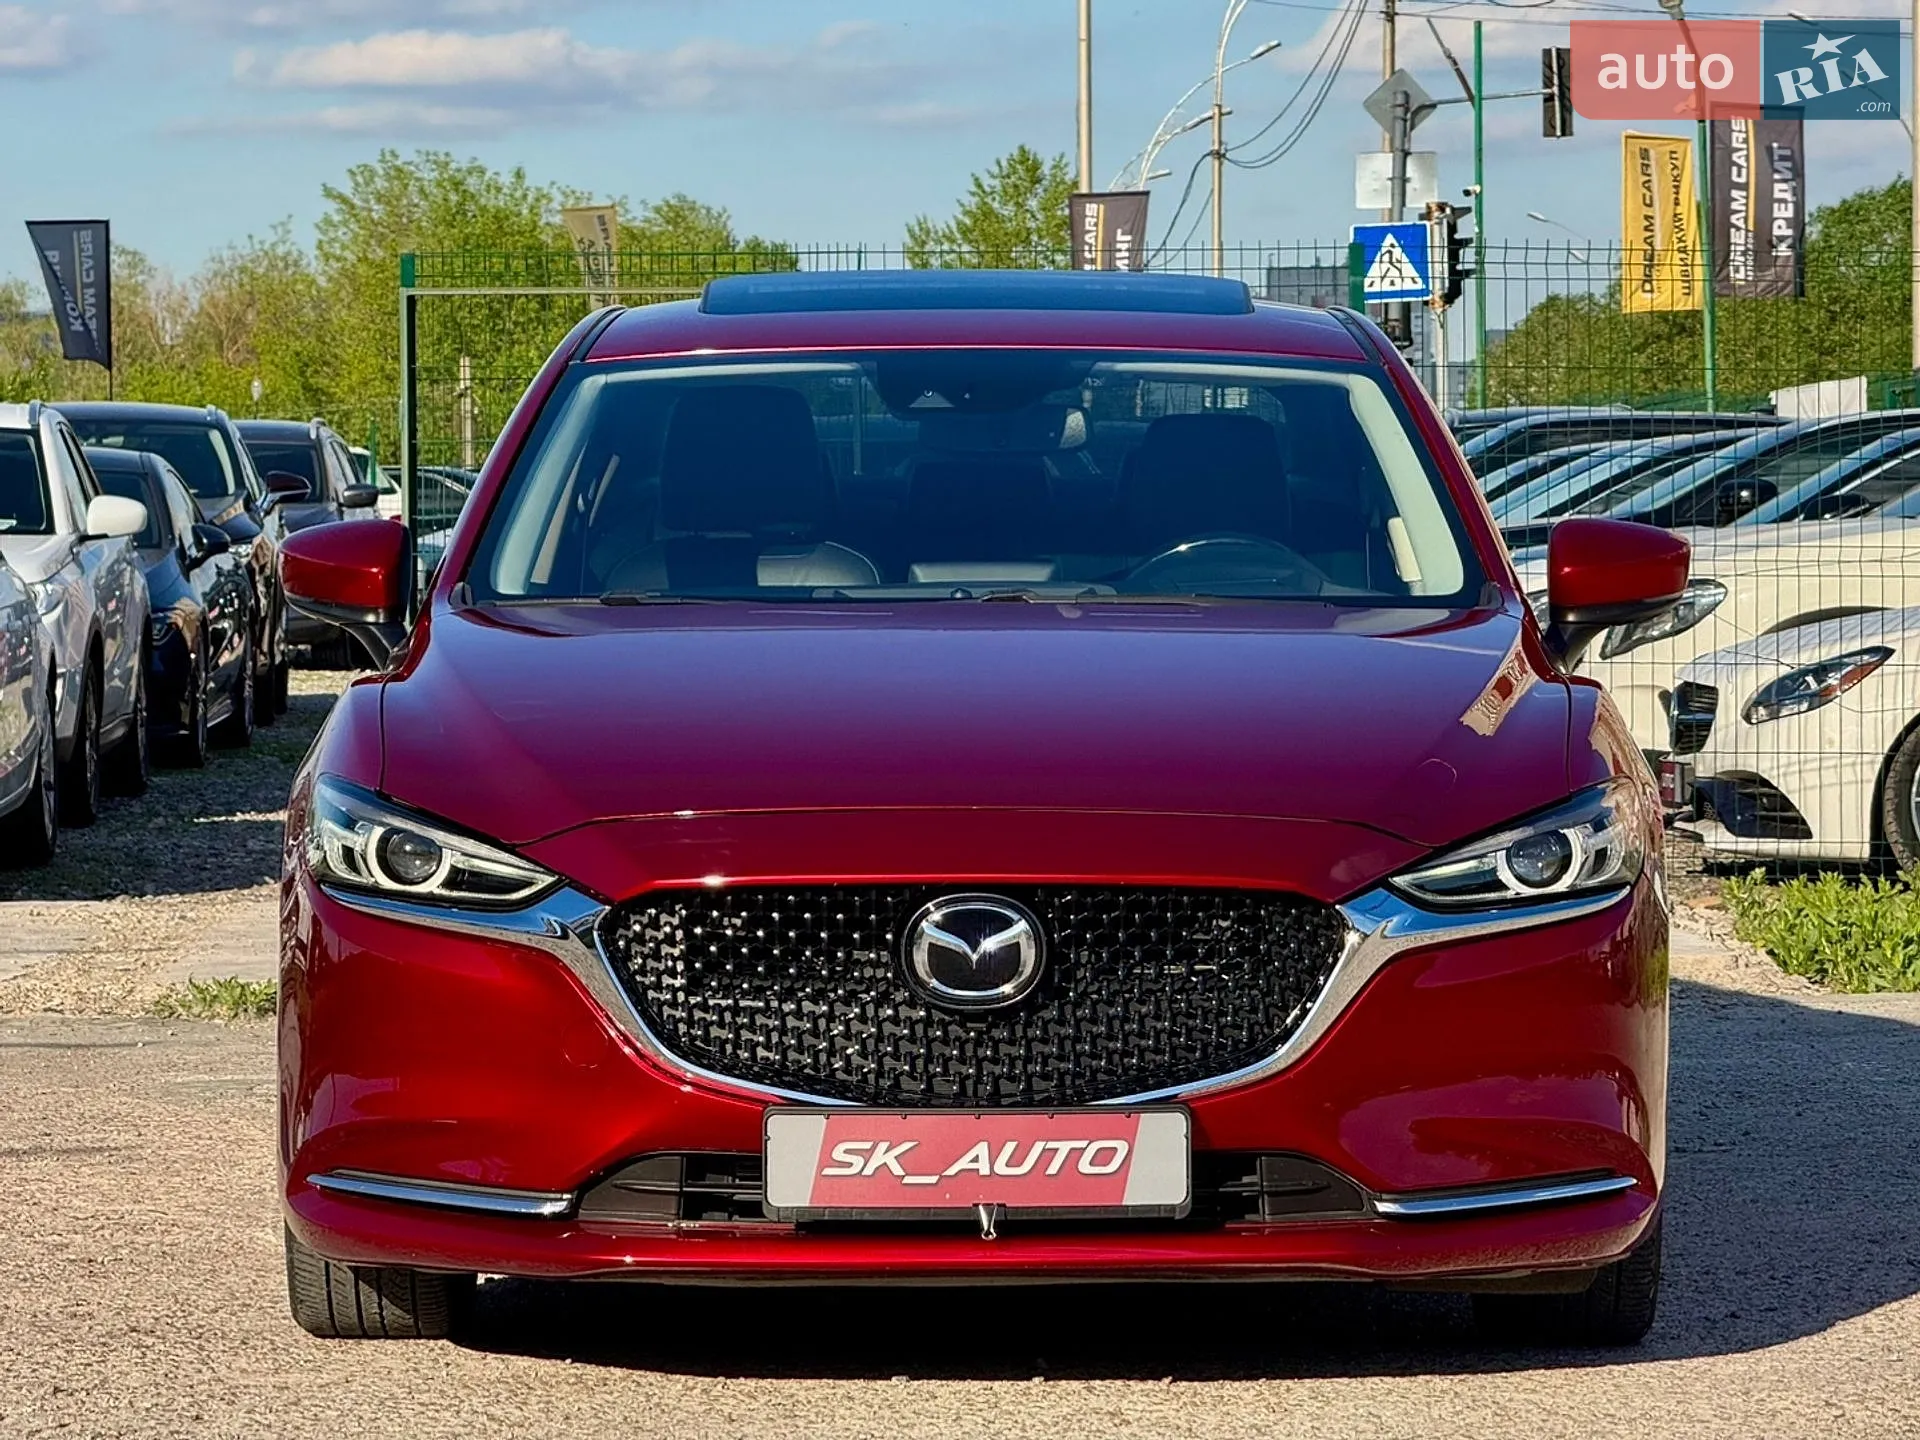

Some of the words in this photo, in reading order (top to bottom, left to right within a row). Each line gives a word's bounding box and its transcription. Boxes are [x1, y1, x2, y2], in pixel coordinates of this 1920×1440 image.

[1639, 146, 1654, 208] CARS
[1730, 115, 1749, 183] CARS
[1083, 203, 1099, 258] CARS
[1771, 142, 1796, 256] КРЕДИТ
[1640, 214, 1656, 294] DREAM
[1729, 189, 1748, 284] DREAM
[821, 1139, 1130, 1185] SK_AUTO
